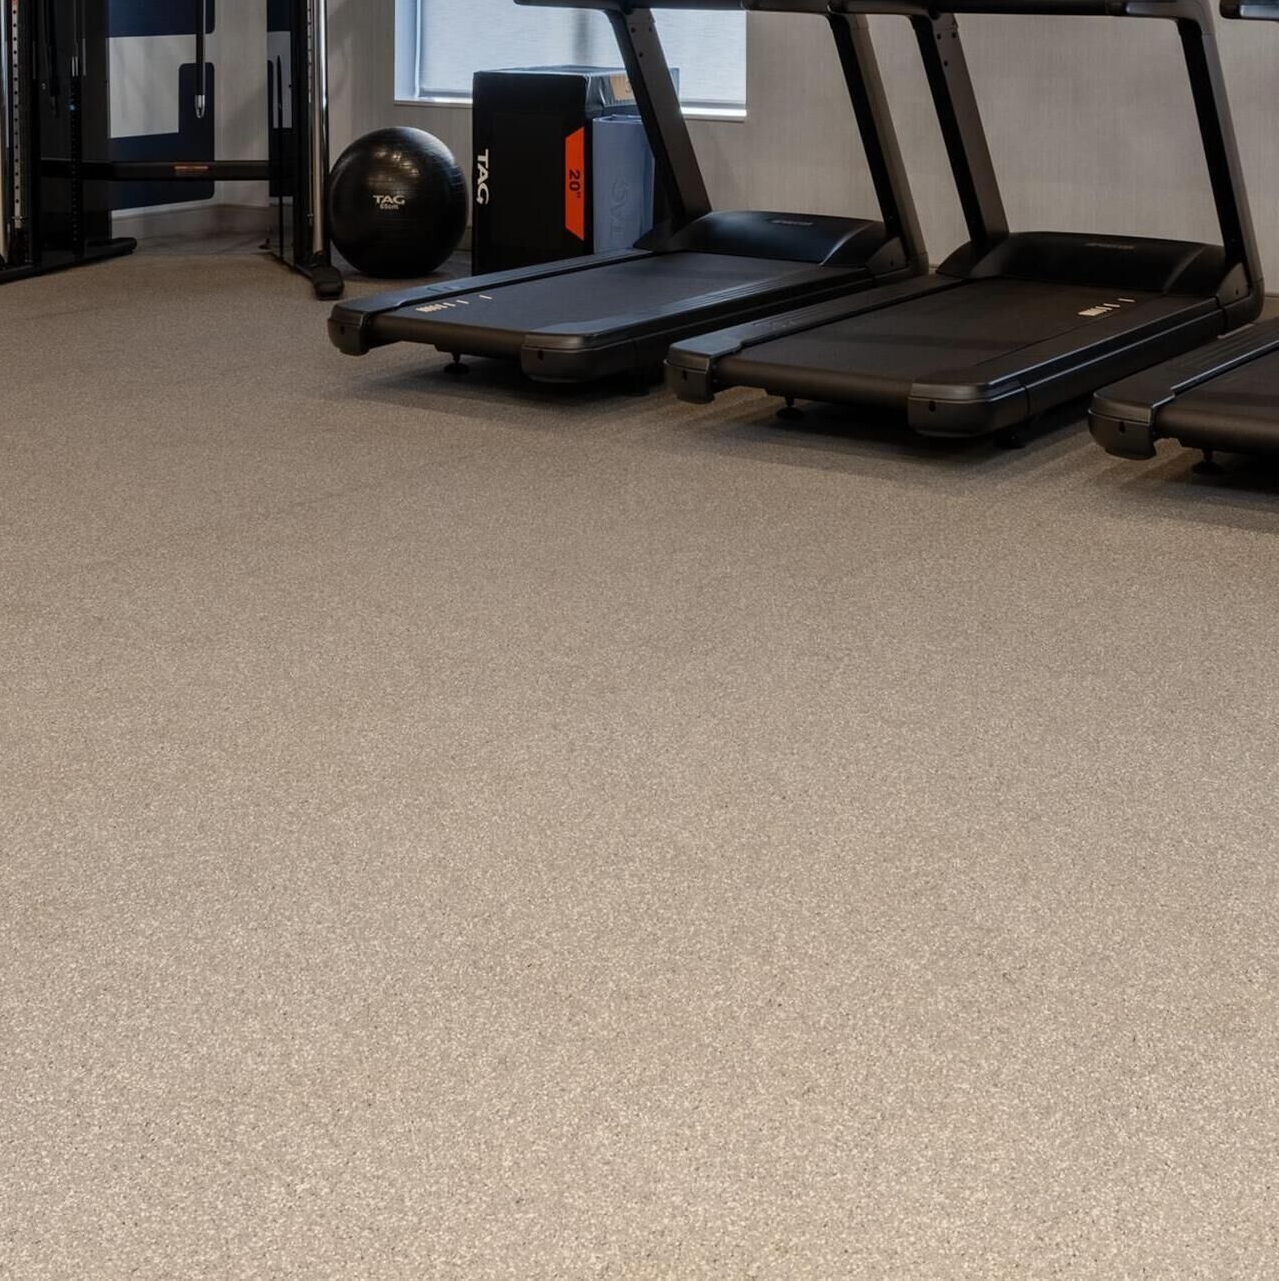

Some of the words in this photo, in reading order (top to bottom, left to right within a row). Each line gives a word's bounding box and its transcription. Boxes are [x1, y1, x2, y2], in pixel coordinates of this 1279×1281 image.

[476, 148, 490, 205] TAG
[569, 169, 582, 199] 20"
[373, 194, 406, 205] TAG
